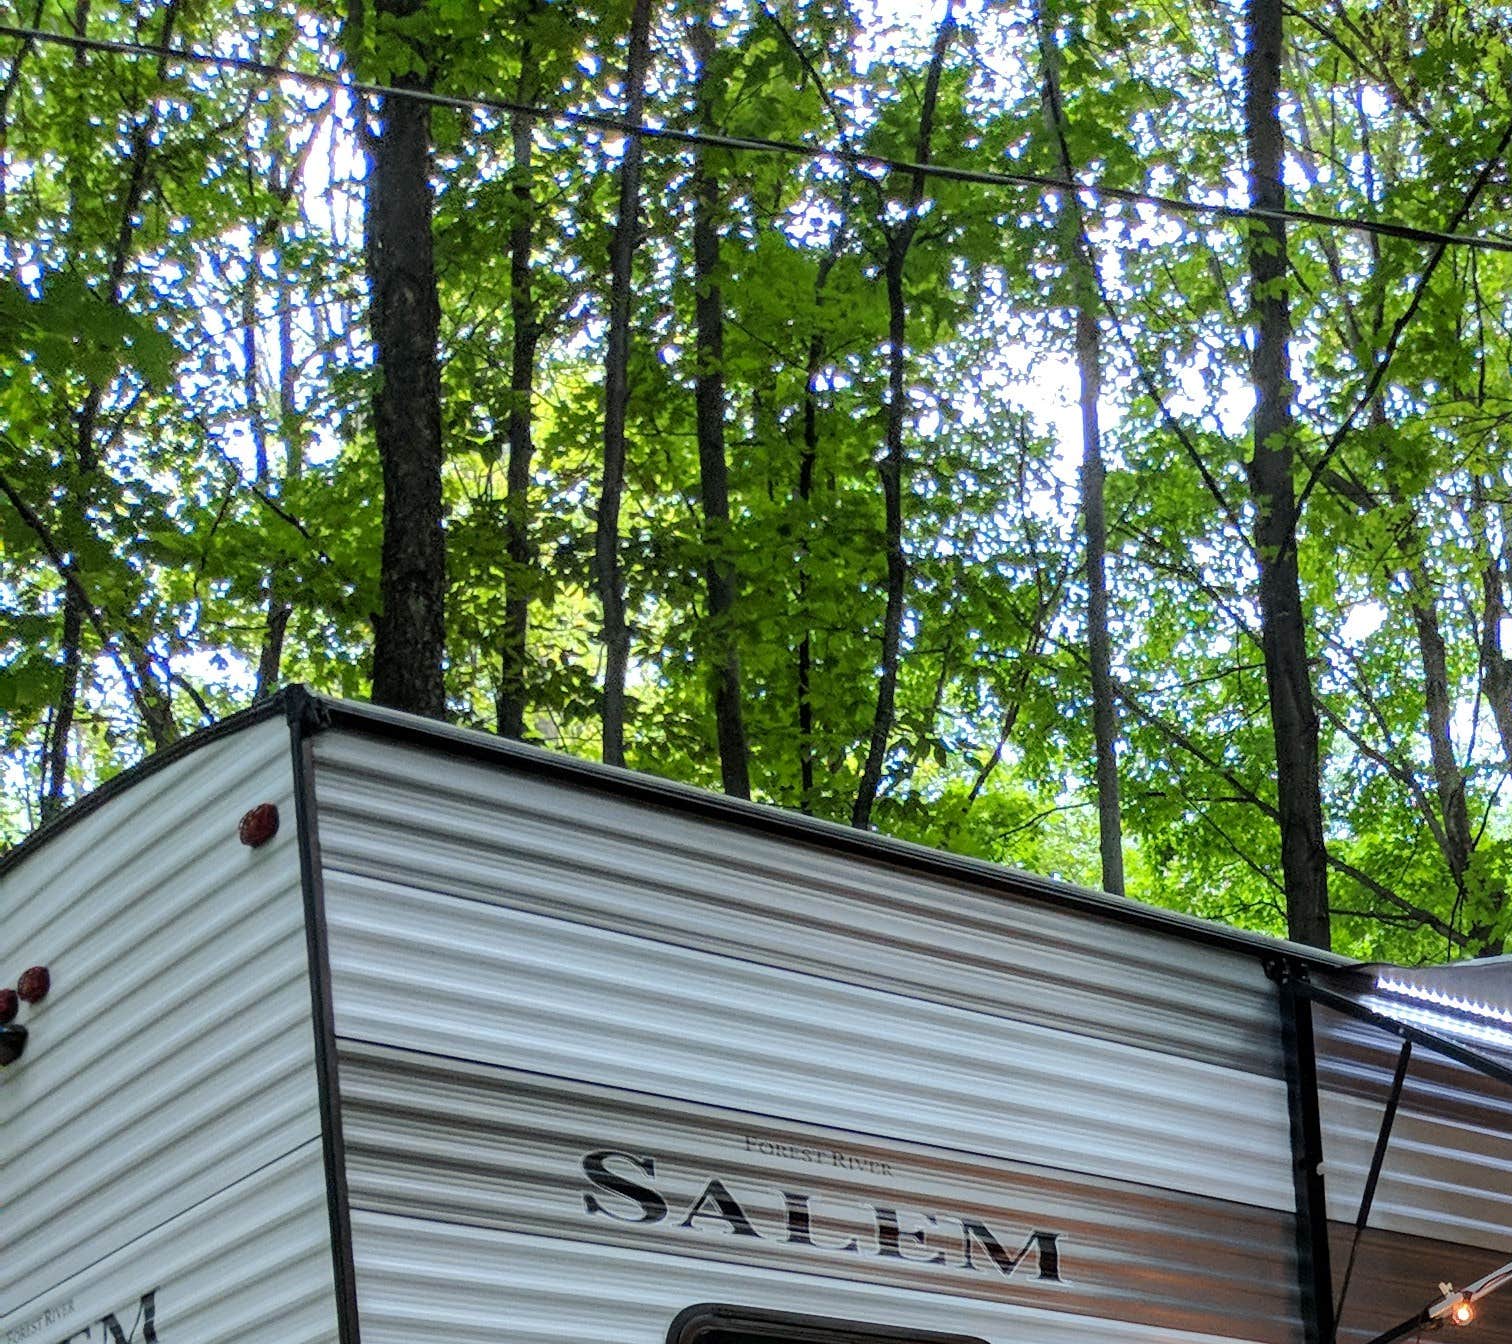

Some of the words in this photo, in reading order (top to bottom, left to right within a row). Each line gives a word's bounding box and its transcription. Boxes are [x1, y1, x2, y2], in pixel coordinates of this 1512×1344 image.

[745, 1135, 831, 1165] FOREST
[831, 1150, 895, 1178] RIVER
[579, 1149, 1070, 1284] SALEM
